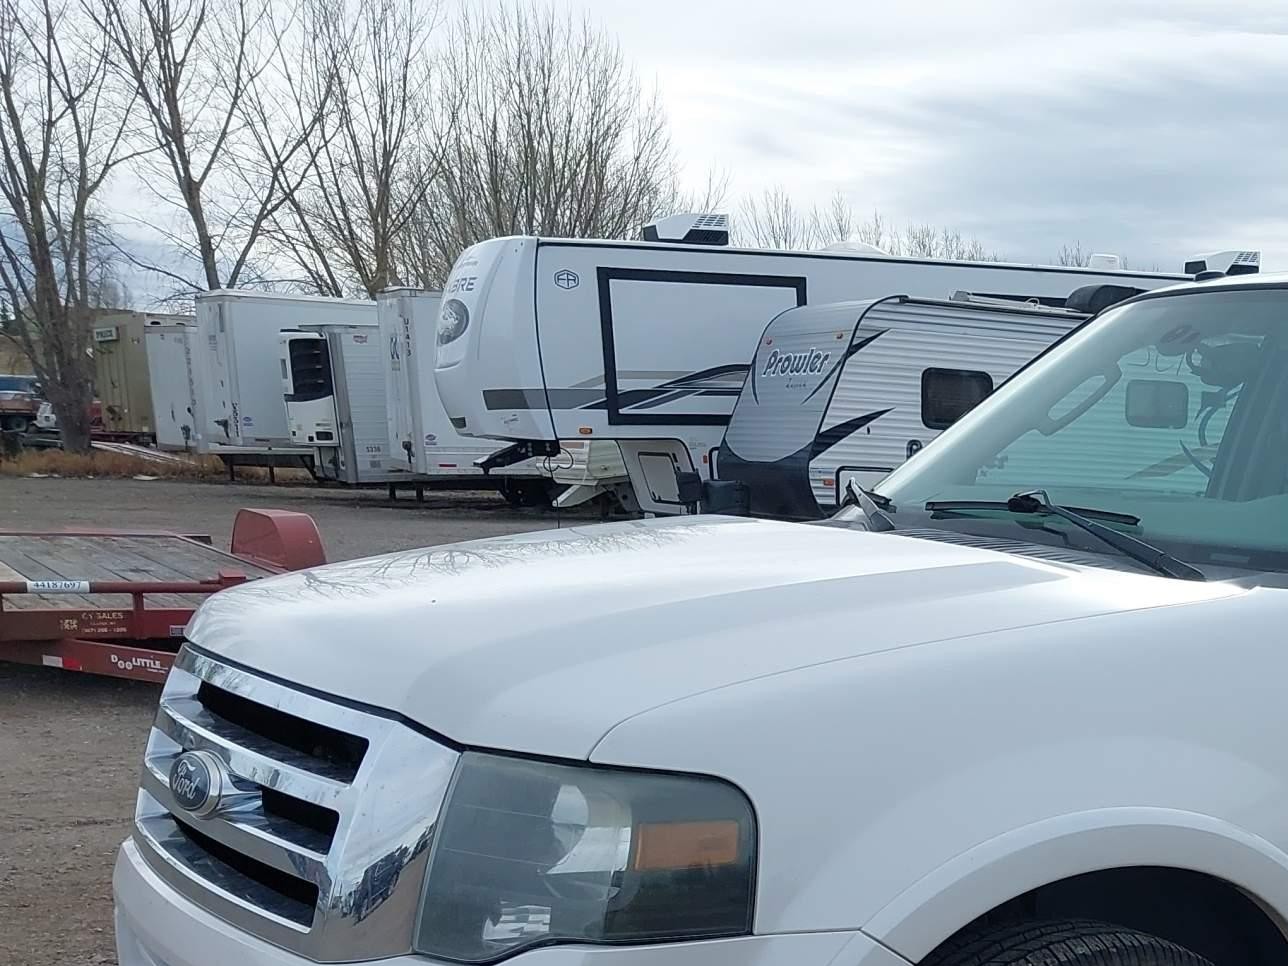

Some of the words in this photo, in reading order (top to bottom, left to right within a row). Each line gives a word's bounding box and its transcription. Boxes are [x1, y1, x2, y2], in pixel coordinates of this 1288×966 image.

[761, 346, 832, 378] Prowler
[96, 612, 124, 620] SALES
[111, 654, 161, 670] DOOLITTLE
[172, 759, 200, 800] Ford
